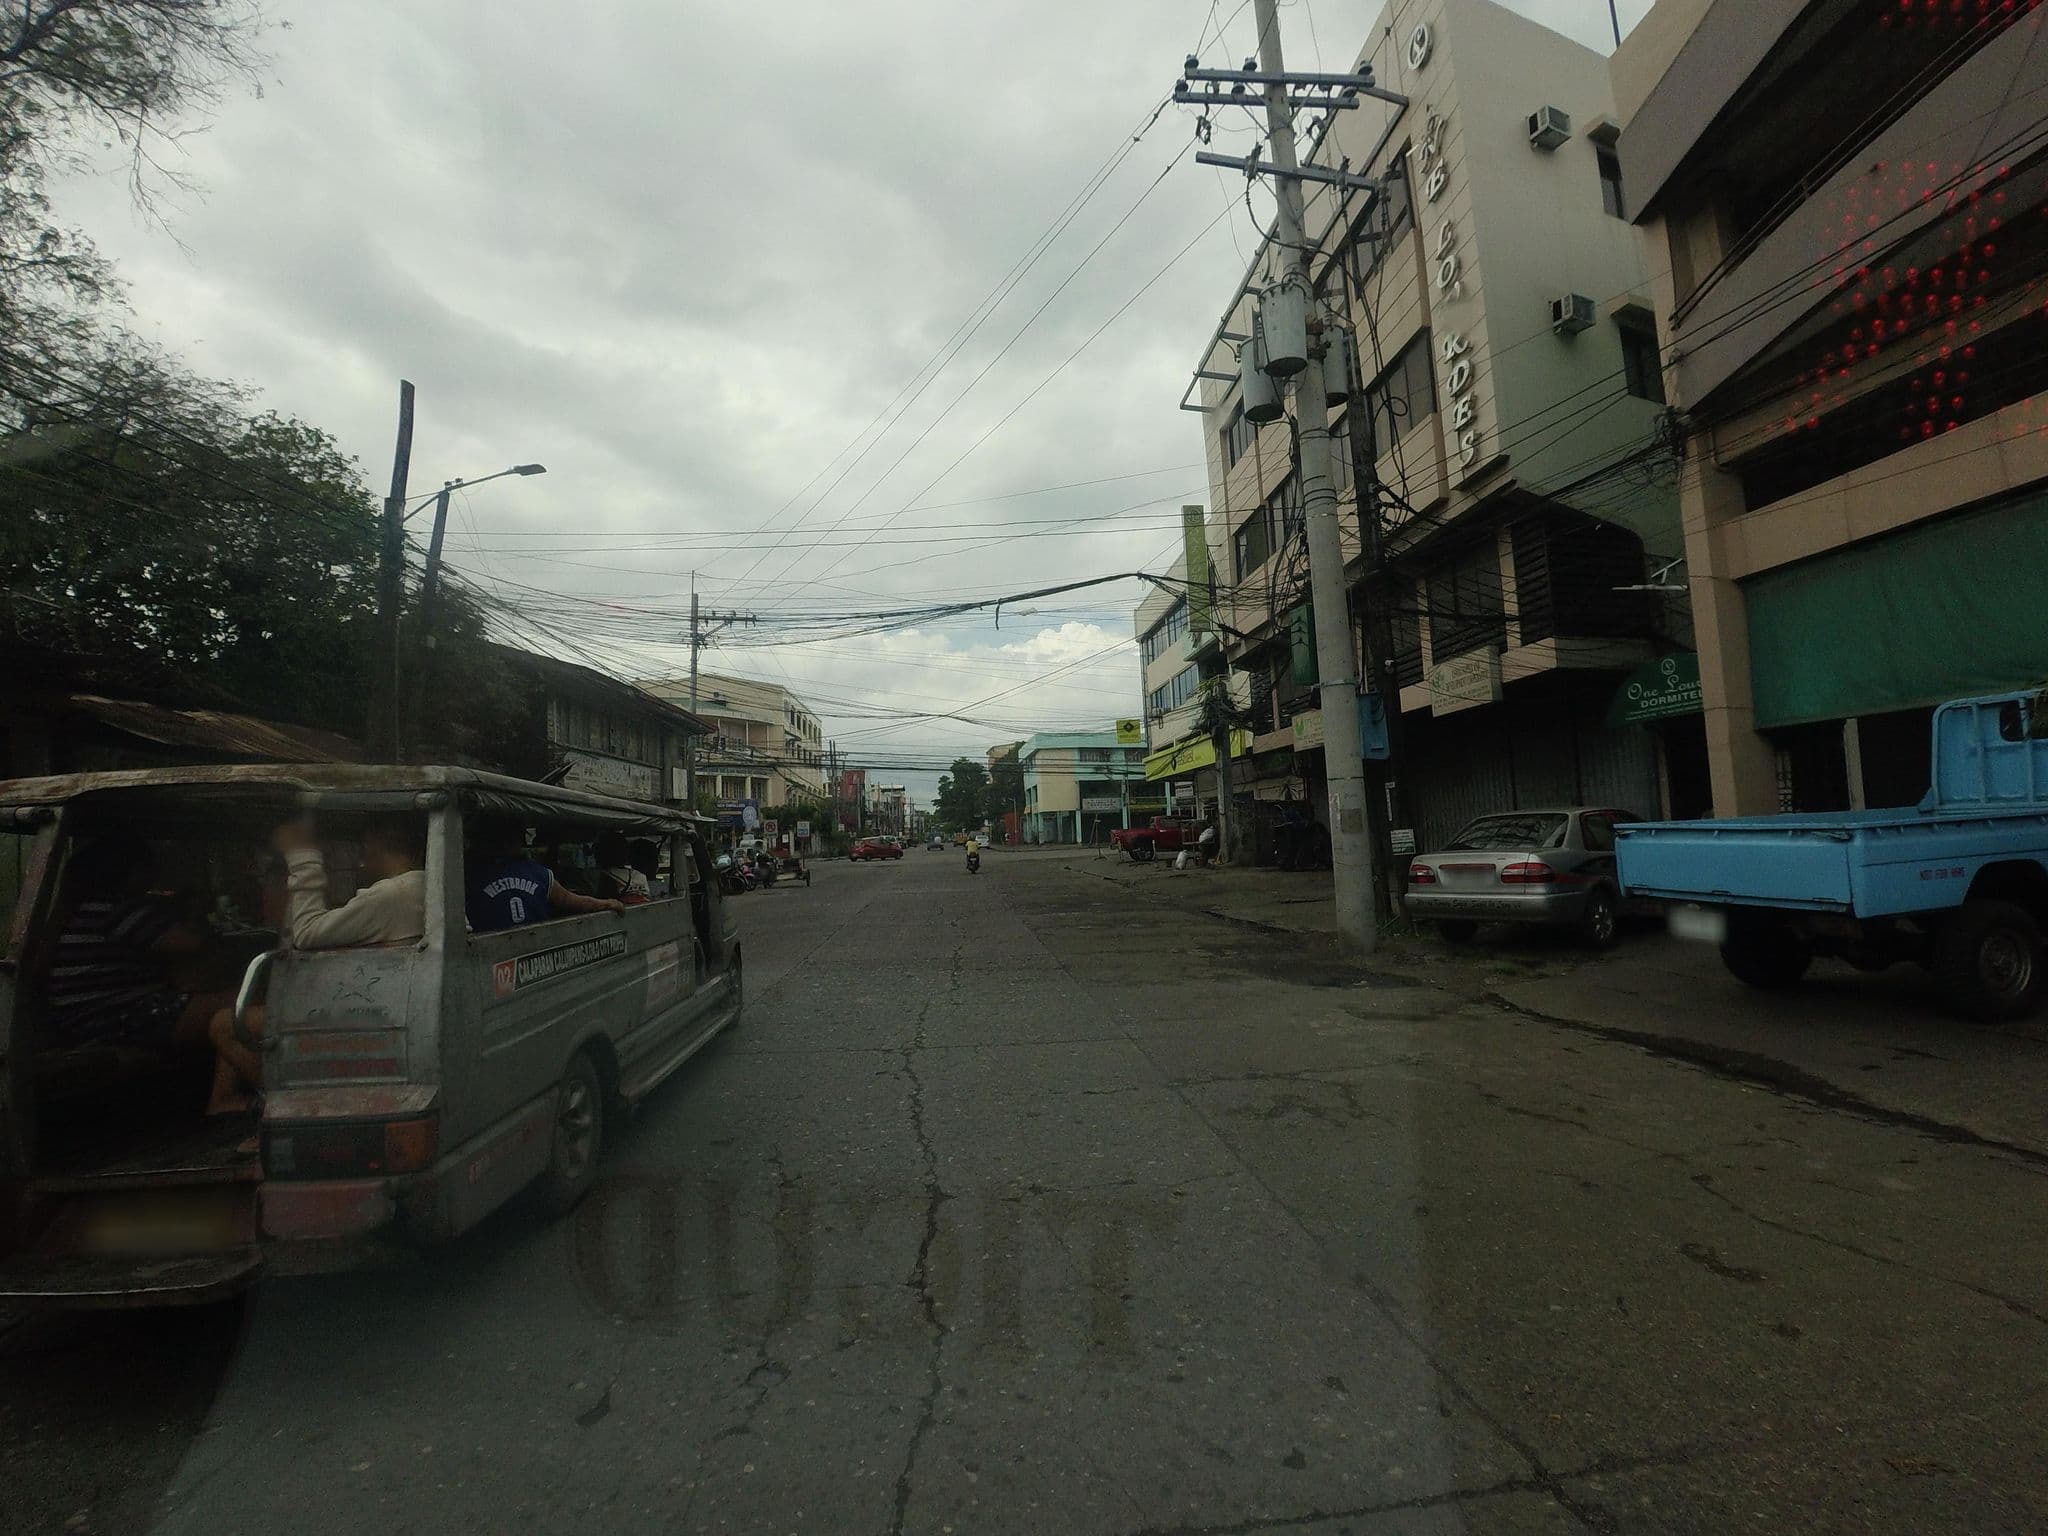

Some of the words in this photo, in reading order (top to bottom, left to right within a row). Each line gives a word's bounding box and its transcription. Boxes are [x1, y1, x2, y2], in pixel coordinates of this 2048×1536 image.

[1435, 219, 1475, 467] LORDES
[1628, 682, 1659, 700] One
[483, 877, 539, 899] WESTBROOK
[509, 896, 526, 923] 0
